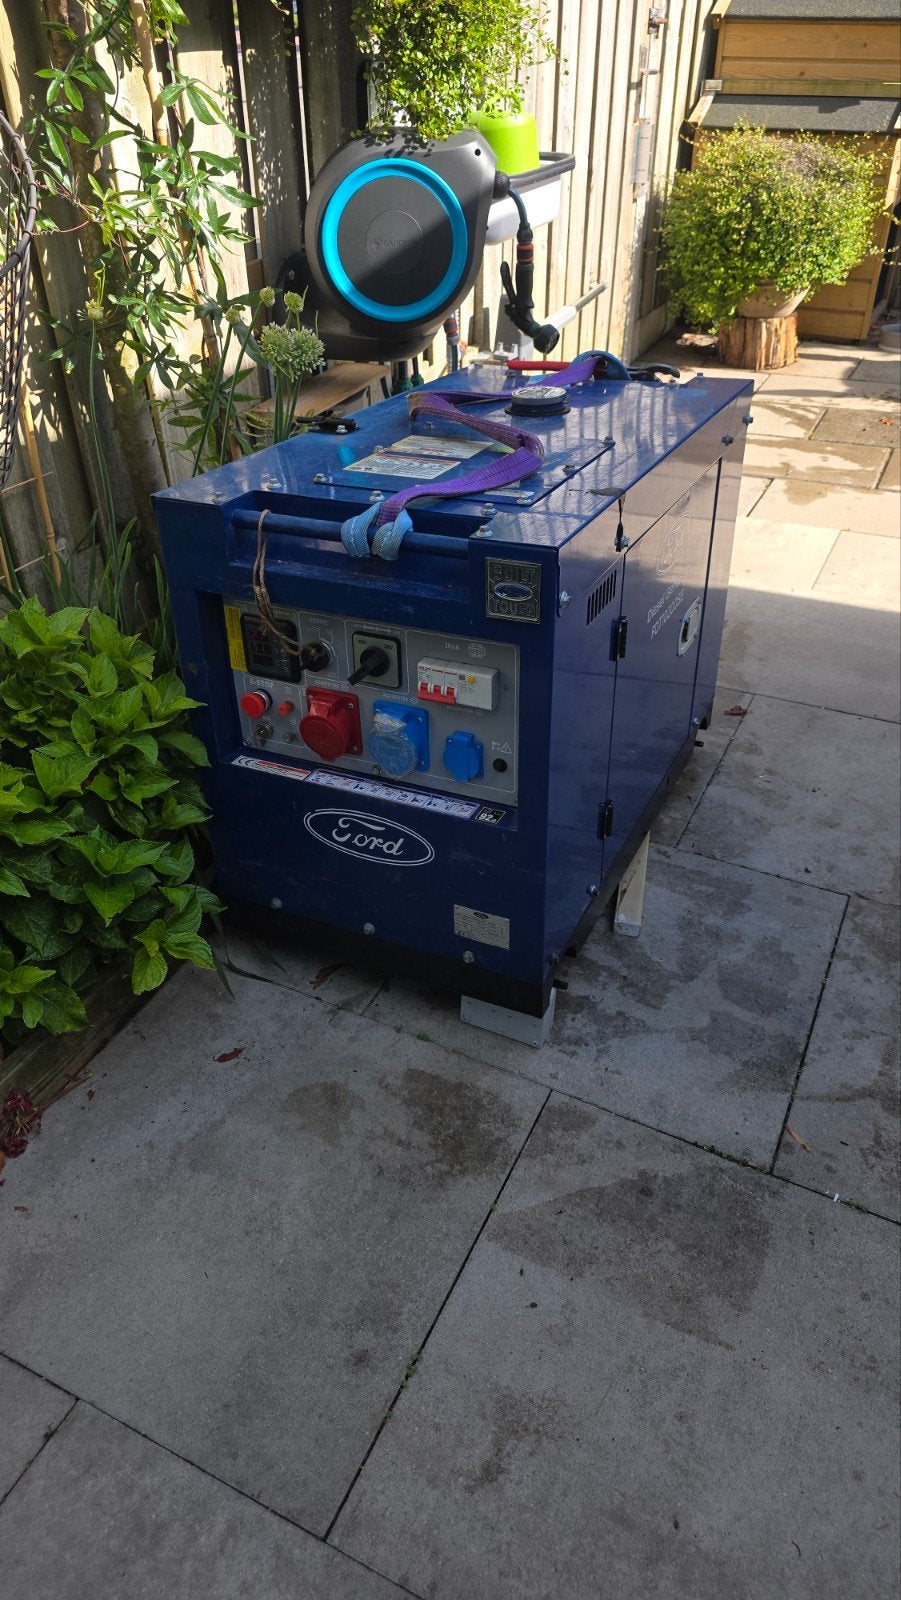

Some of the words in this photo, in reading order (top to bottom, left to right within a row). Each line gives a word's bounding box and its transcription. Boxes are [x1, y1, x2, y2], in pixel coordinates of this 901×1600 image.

[491, 563, 536, 585] BUILT
[249, 677, 275, 689] E-STOP
[478, 812, 494, 822] 92
[331, 816, 405, 856] Ford
